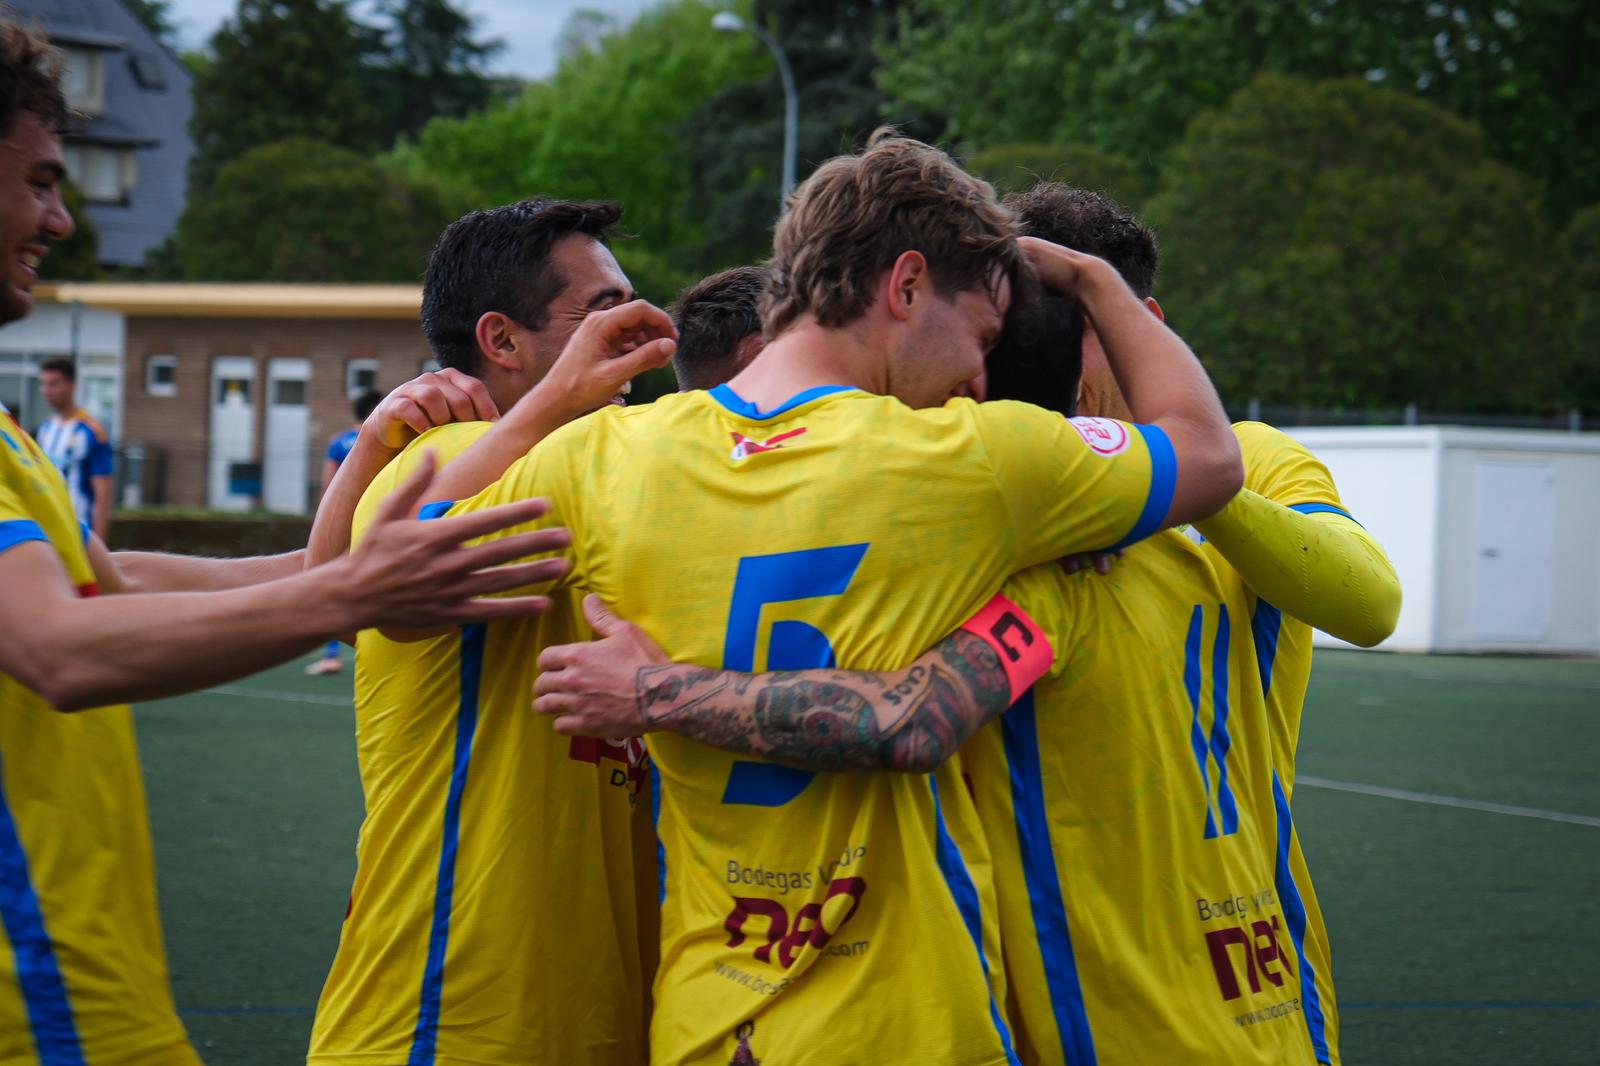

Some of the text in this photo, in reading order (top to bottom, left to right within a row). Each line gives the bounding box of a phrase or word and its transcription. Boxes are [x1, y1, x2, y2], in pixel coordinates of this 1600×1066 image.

[989, 611, 1034, 662] C
[720, 542, 871, 808] 5
[727, 860, 813, 895] Bodegas
